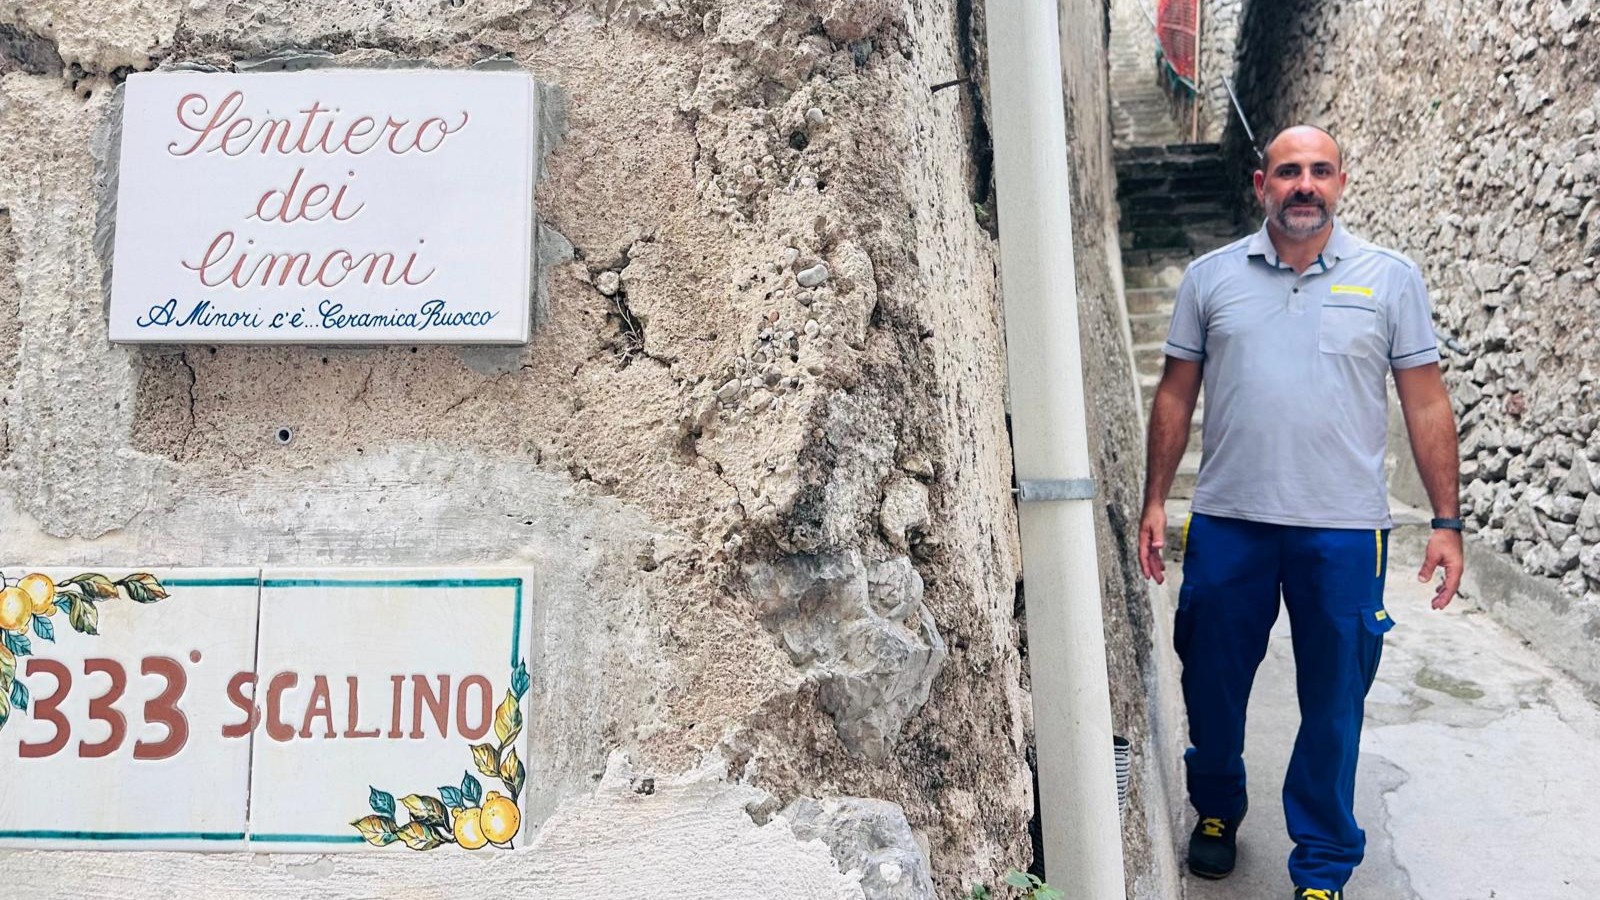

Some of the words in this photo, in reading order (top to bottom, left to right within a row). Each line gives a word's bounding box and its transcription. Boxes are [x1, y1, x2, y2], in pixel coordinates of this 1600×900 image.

[167, 90, 469, 157] Sentiero
[245, 168, 365, 223] dei
[181, 231, 437, 288] limoni
[136, 299, 177, 328] A
[175, 299, 263, 328] Minori
[318, 299, 420, 329] Ceramica
[418, 299, 500, 330] Ruocco
[221, 671, 494, 742] SCALINO
